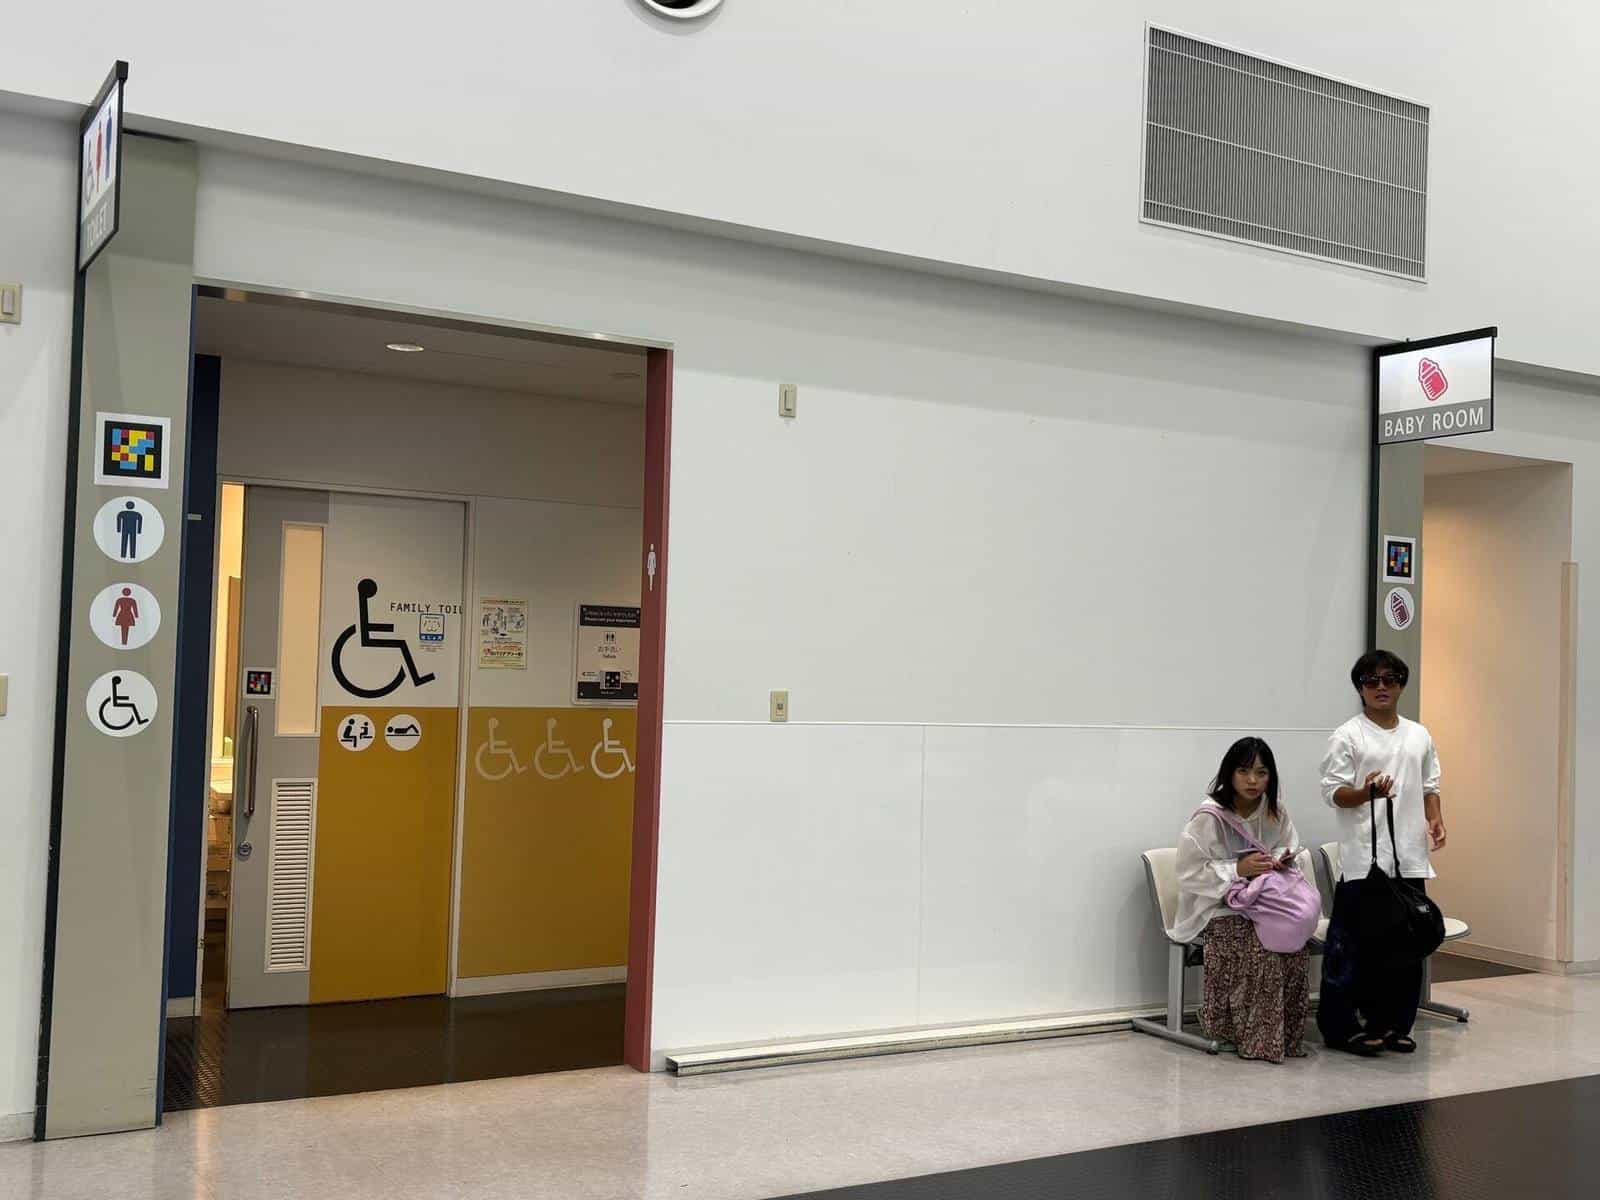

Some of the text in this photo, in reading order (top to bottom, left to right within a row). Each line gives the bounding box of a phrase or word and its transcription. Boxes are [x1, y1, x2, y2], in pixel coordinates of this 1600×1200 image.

[1384, 406, 1484, 437] BABY ROOM
[389, 602, 431, 614] FAMILY
